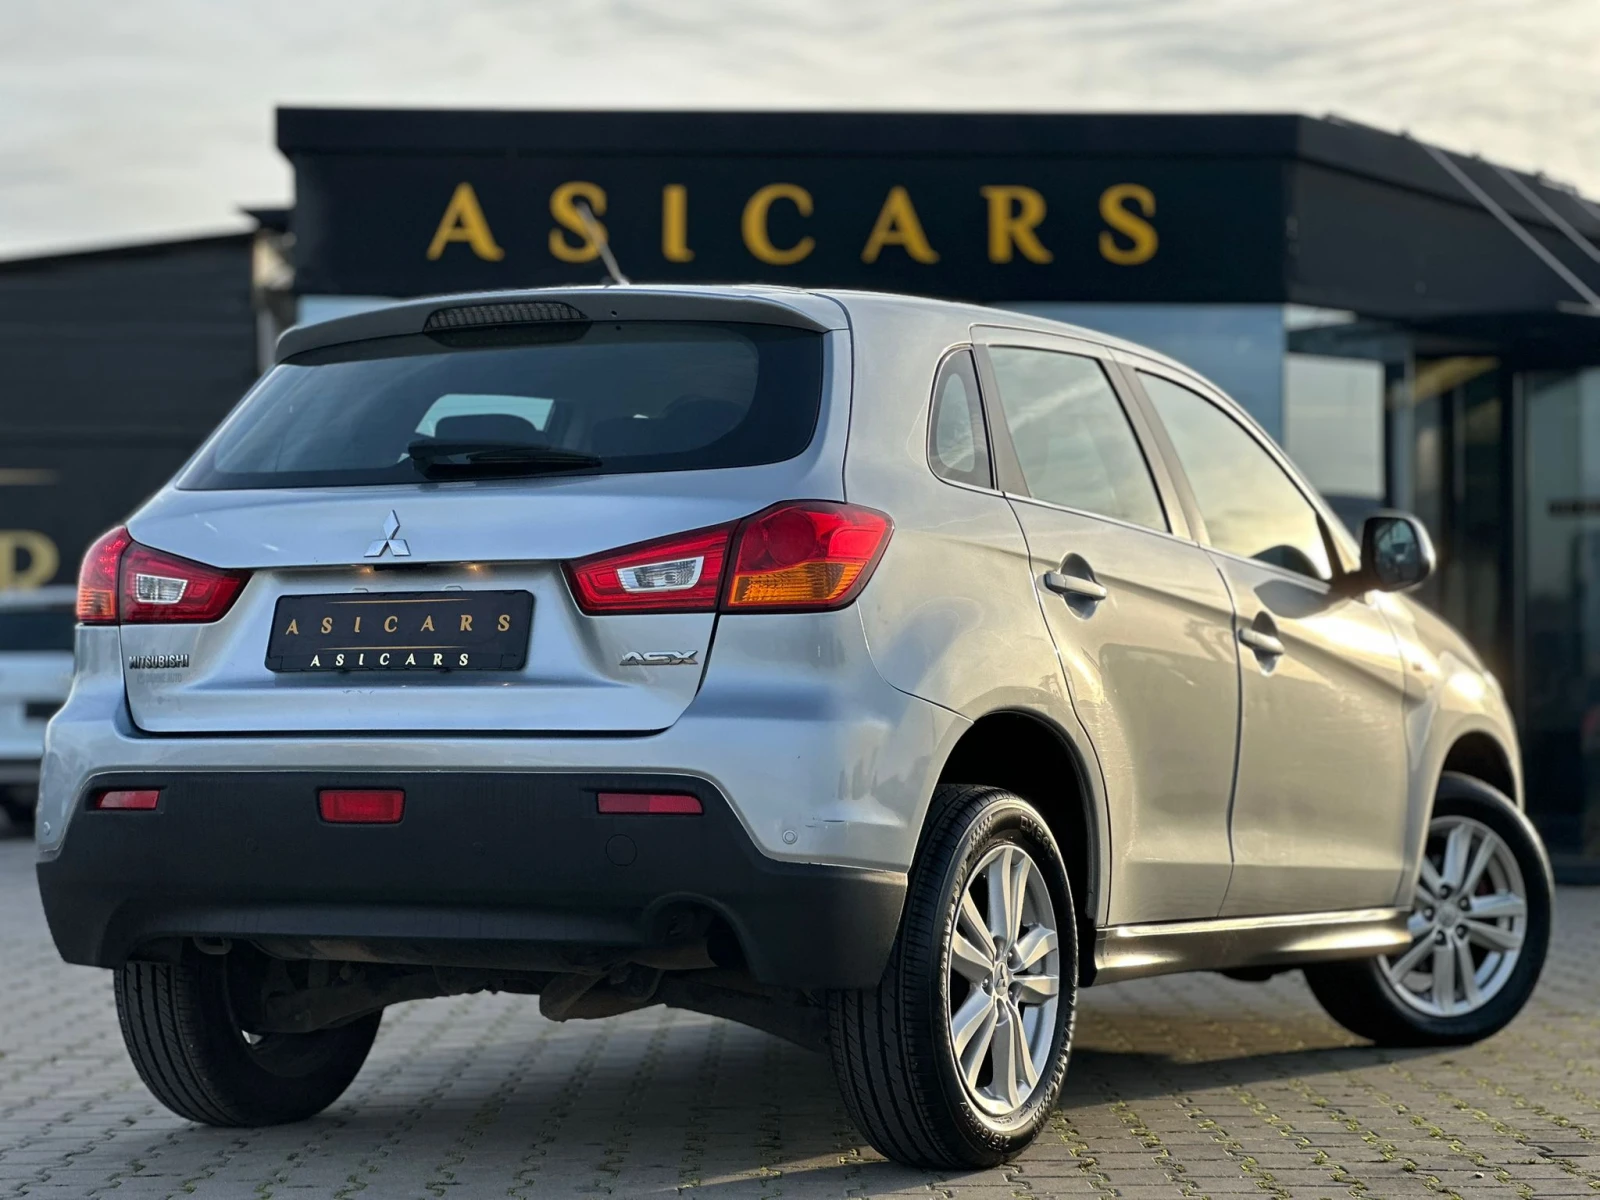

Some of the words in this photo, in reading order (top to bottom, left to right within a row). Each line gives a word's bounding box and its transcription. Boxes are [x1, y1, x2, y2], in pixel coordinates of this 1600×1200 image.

[427, 182, 1159, 265] ASICARS
[286, 614, 511, 635] ASICARS
[128, 654, 190, 669] MITSUBISHI
[310, 653, 469, 667] ASICARS
[619, 650, 698, 666] ASX
